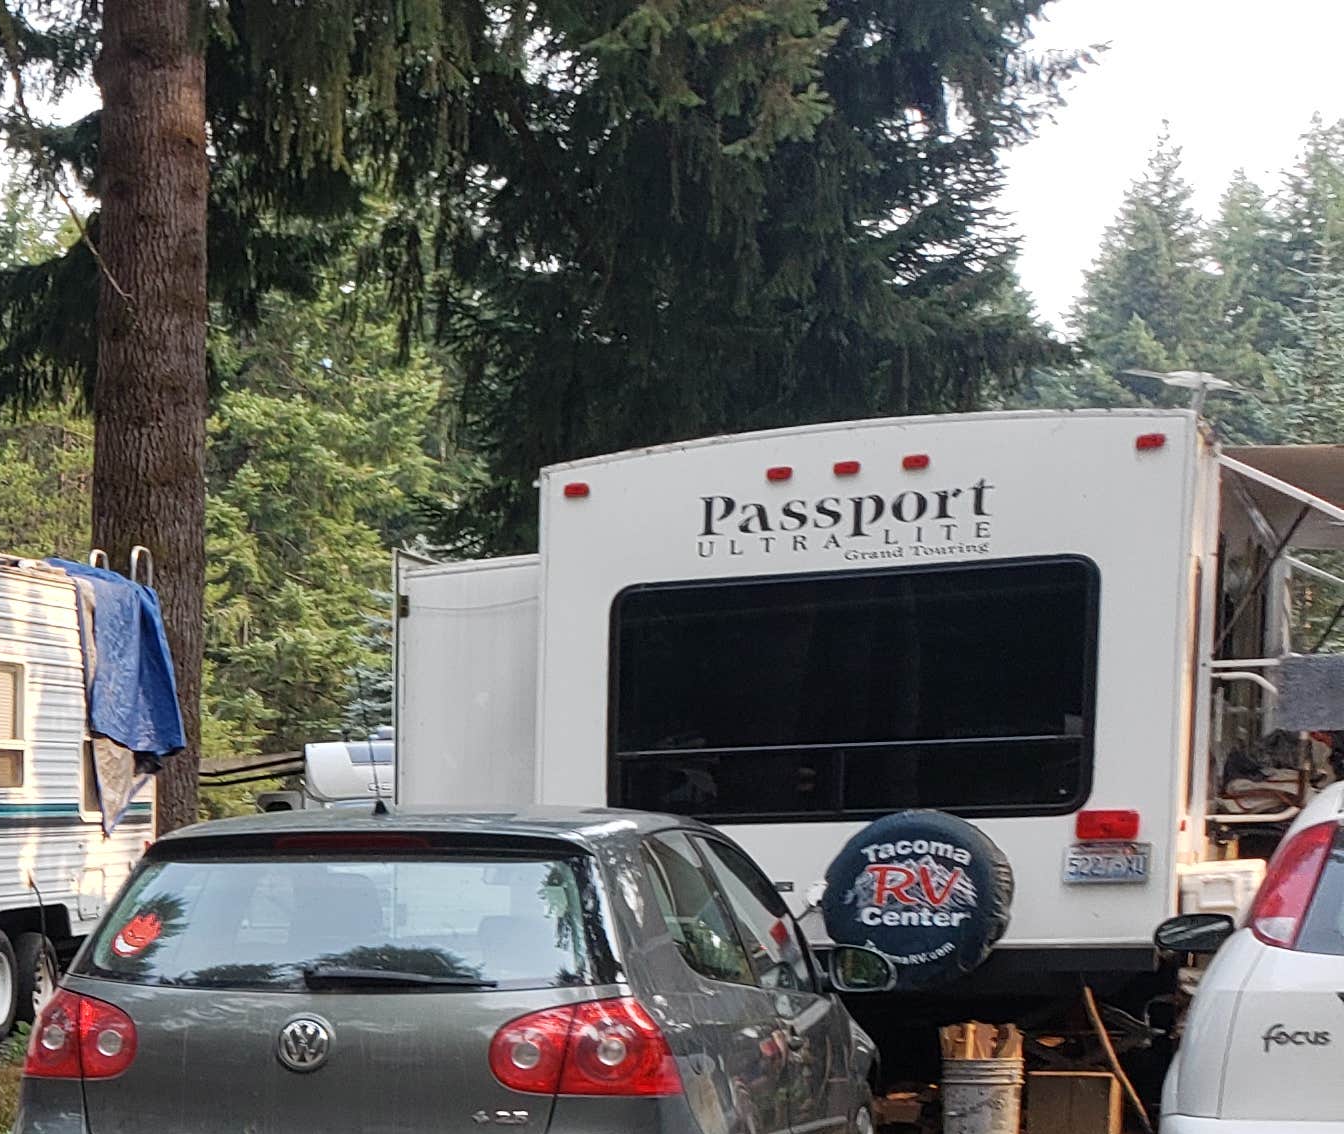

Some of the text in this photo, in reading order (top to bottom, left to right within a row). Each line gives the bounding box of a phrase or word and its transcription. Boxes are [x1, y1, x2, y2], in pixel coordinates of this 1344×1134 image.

[696, 477, 996, 538] Passport
[697, 520, 992, 559] ULTRA LITE
[843, 540, 991, 561] Grand Touring
[860, 839, 973, 867] Tacoma
[865, 863, 962, 908] RV
[861, 907, 972, 928] Center
[1261, 1023, 1331, 1053] focus
